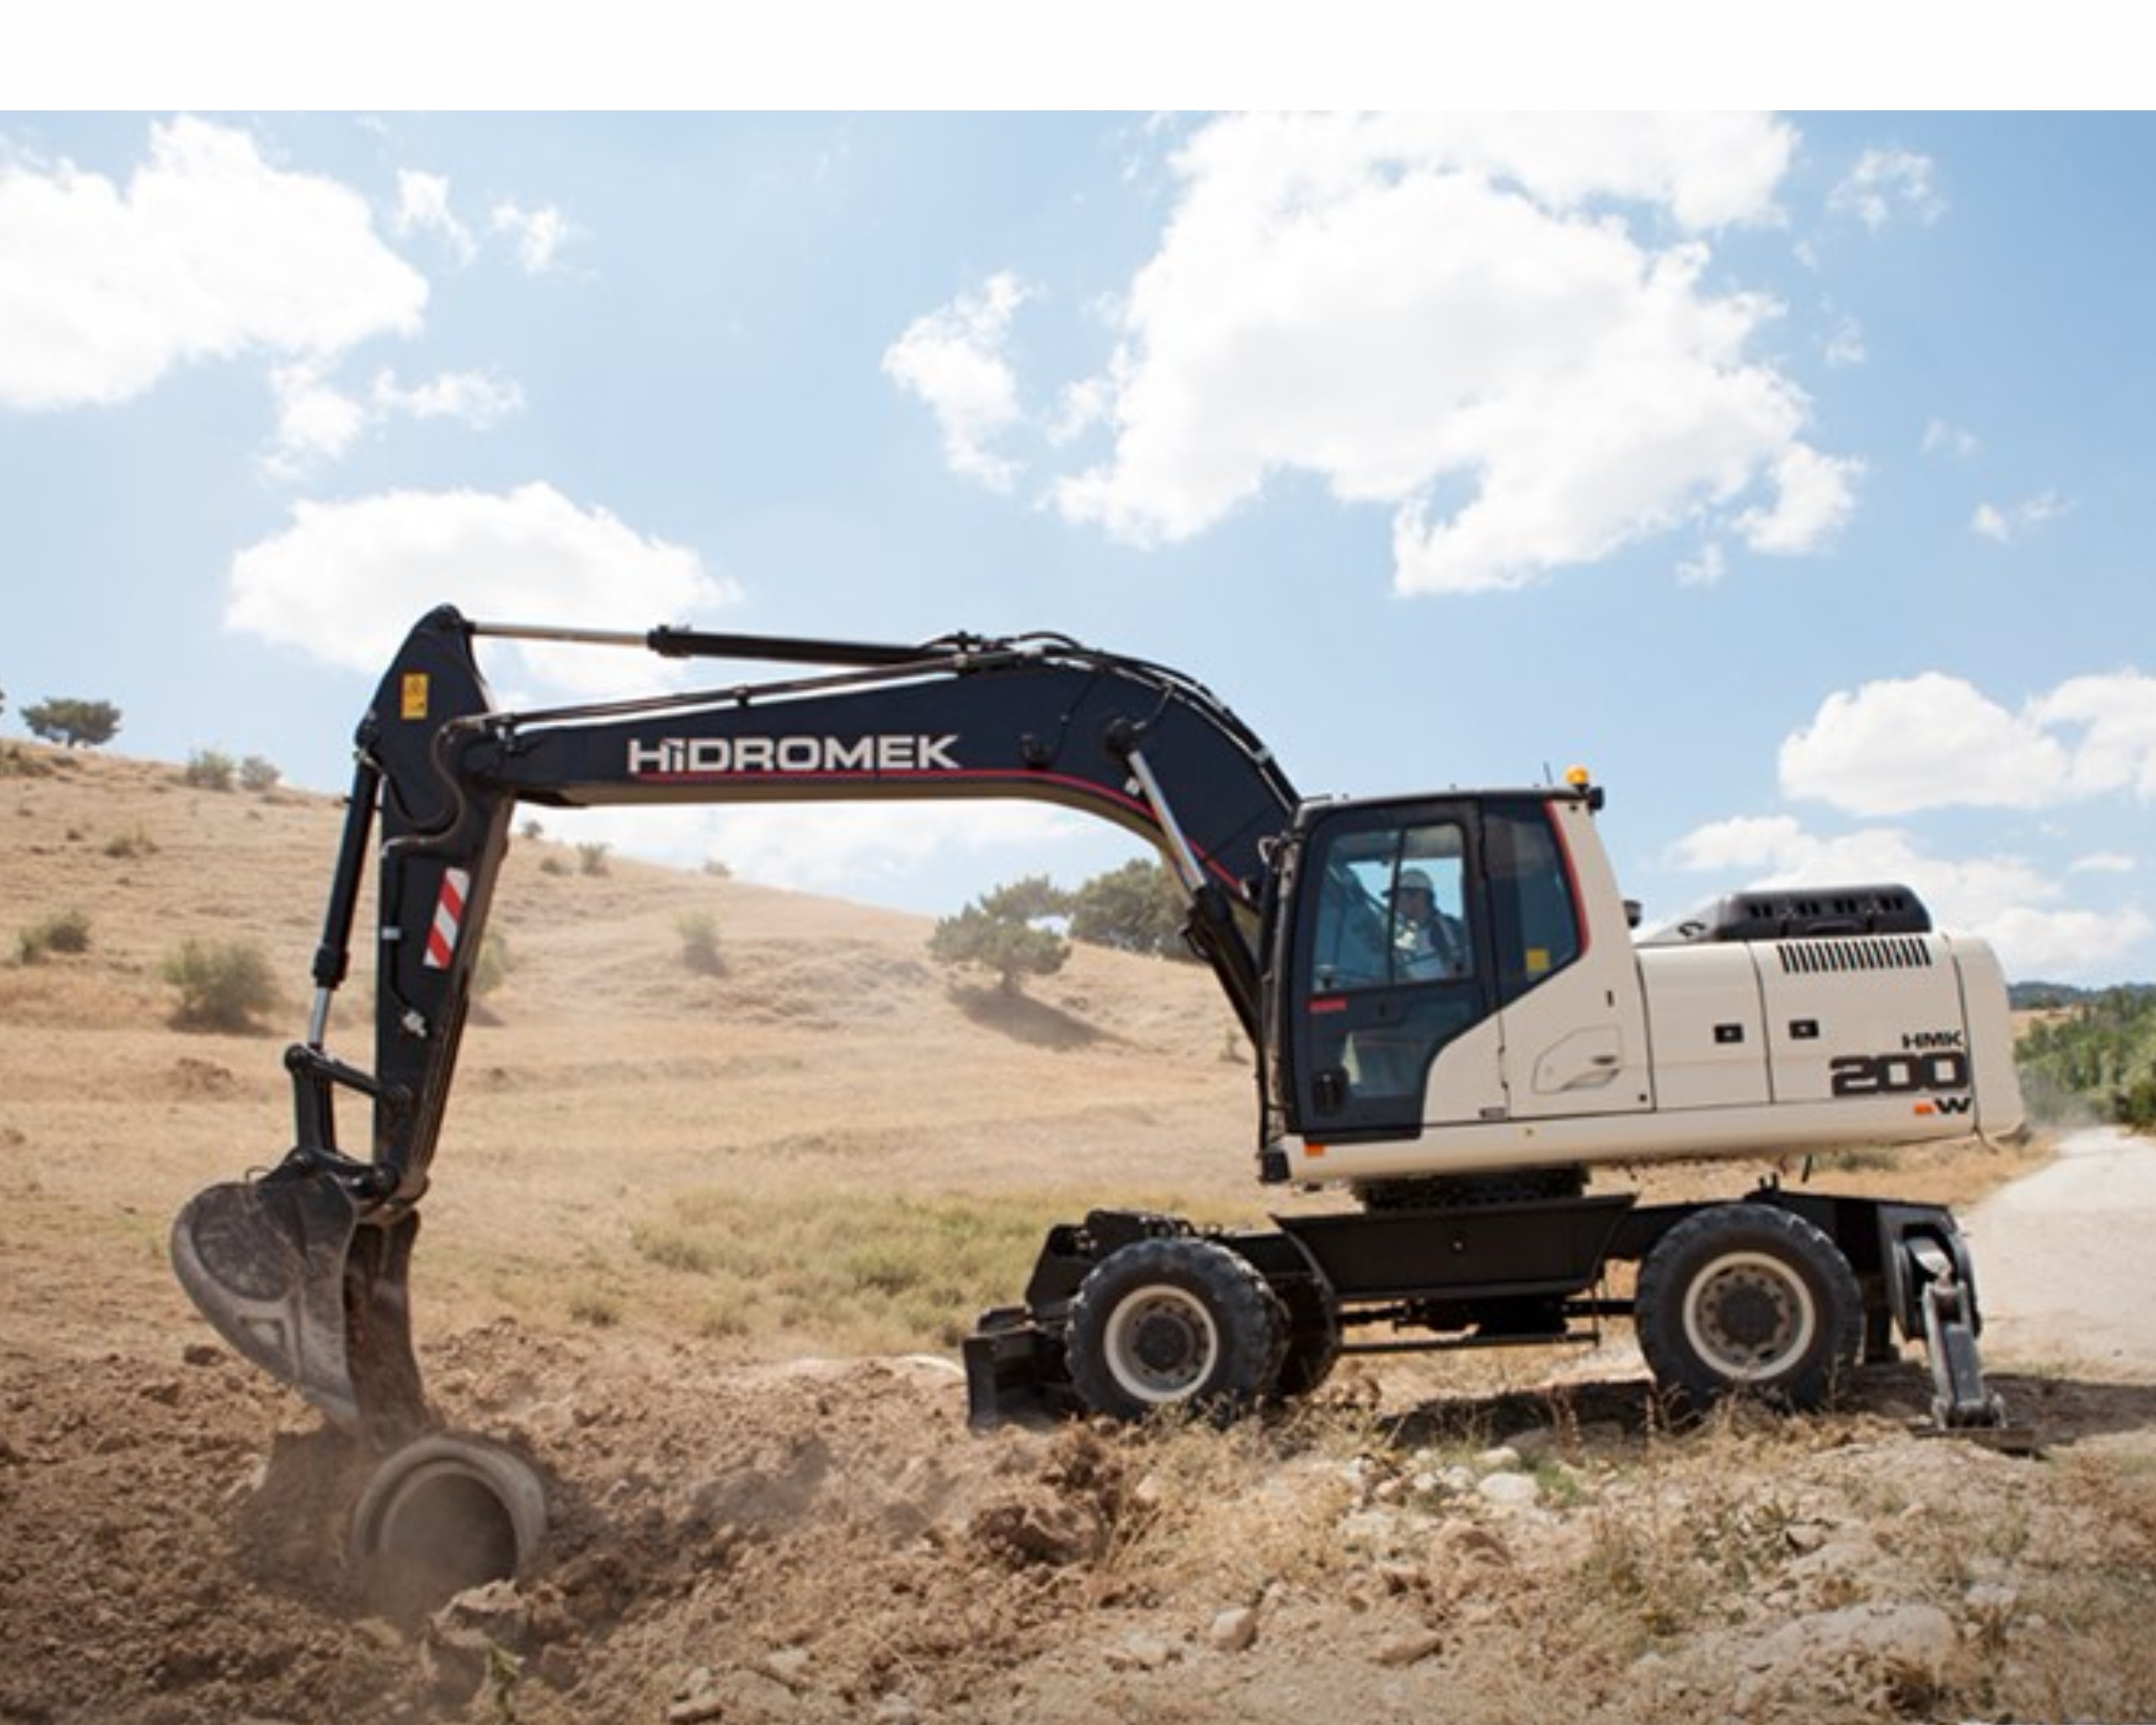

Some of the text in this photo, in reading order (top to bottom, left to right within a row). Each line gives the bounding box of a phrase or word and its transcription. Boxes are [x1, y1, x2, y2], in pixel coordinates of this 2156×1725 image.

[1903, 1031, 1961, 1048] HMK
[1829, 1051, 1969, 1097] 200
[1935, 1097, 1971, 1114] W
